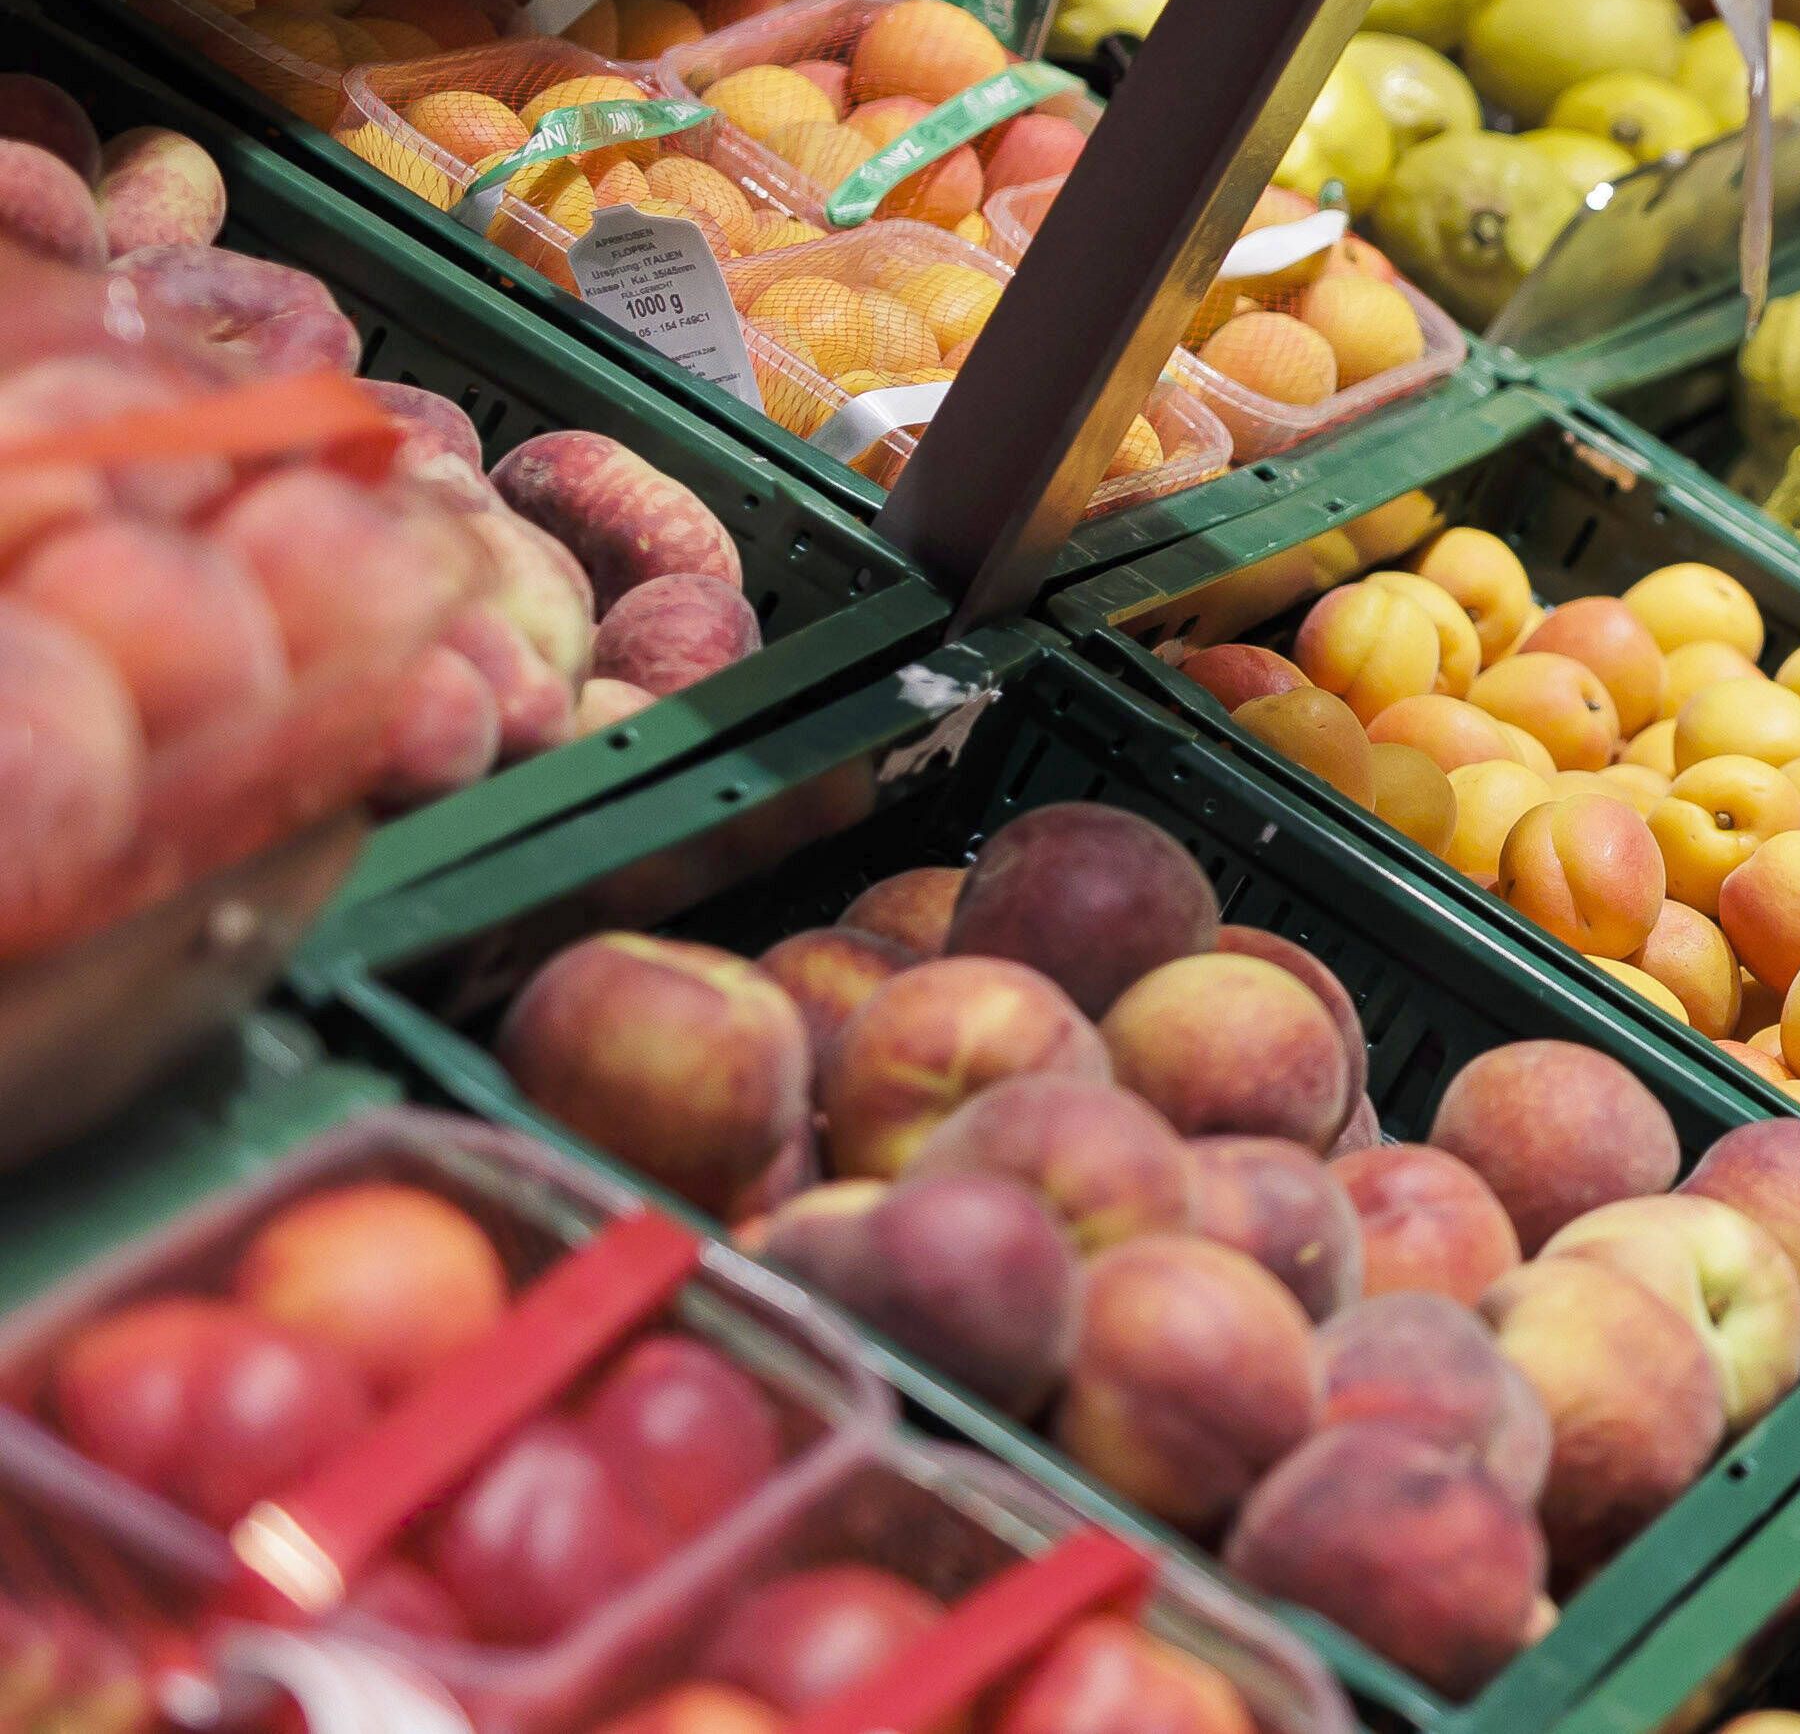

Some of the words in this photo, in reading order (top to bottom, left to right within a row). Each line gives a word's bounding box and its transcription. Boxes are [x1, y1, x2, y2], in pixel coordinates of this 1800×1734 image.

[591, 262, 642, 280] Ursprung:
[643, 249, 683, 267] ITALIEN
[585, 284, 621, 297] Klasse
[626, 294, 667, 320] 1000
[669, 293, 684, 315] g
